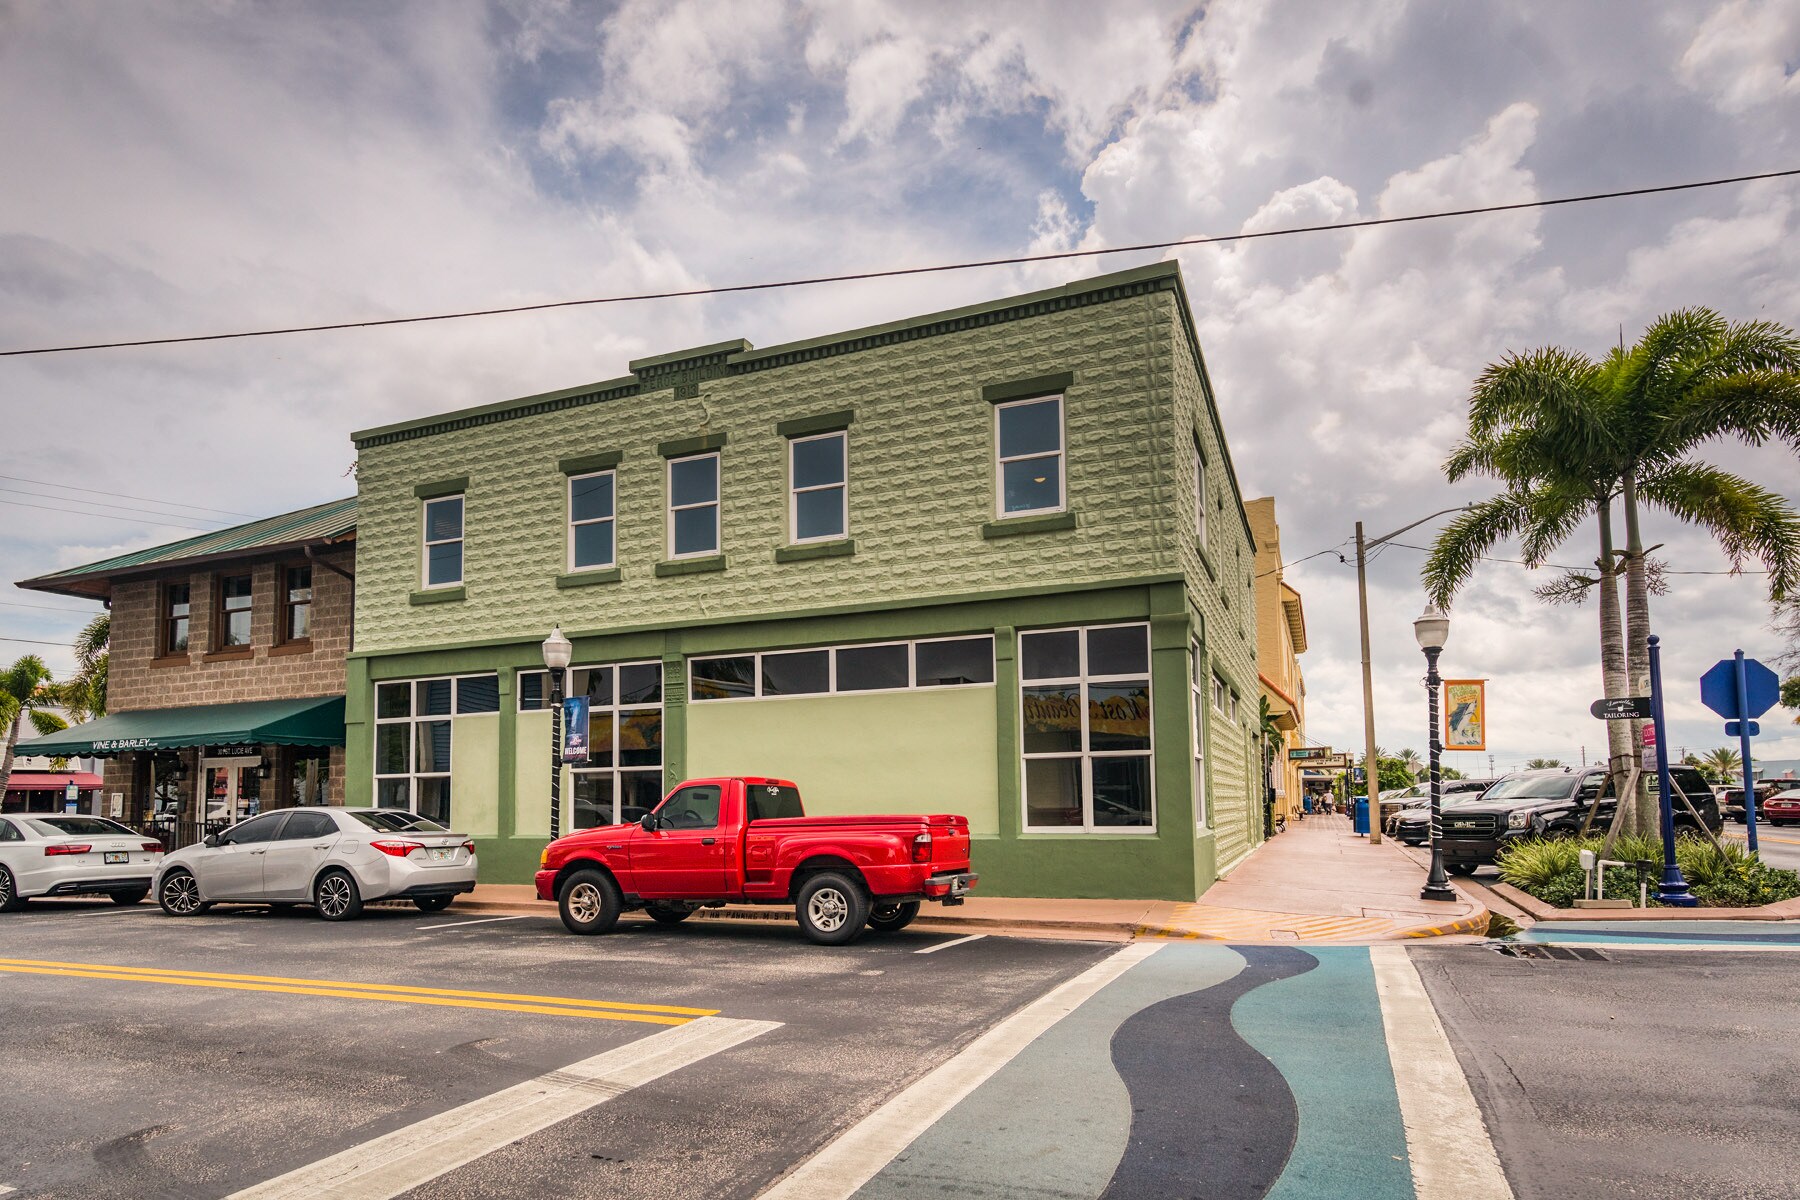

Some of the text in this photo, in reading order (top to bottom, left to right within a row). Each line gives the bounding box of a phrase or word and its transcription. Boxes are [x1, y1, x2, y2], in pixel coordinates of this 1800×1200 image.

[642, 364, 731, 392] FEROE BUILDING
[676, 384, 697, 397] 1913
[1603, 711, 1640, 719] TAILORING
[93, 738, 150, 750] VINE & BARLEY
[565, 747, 587, 755] WELCOME
[1454, 821, 1476, 829] GMC
[726, 911, 757, 919] PARKING
